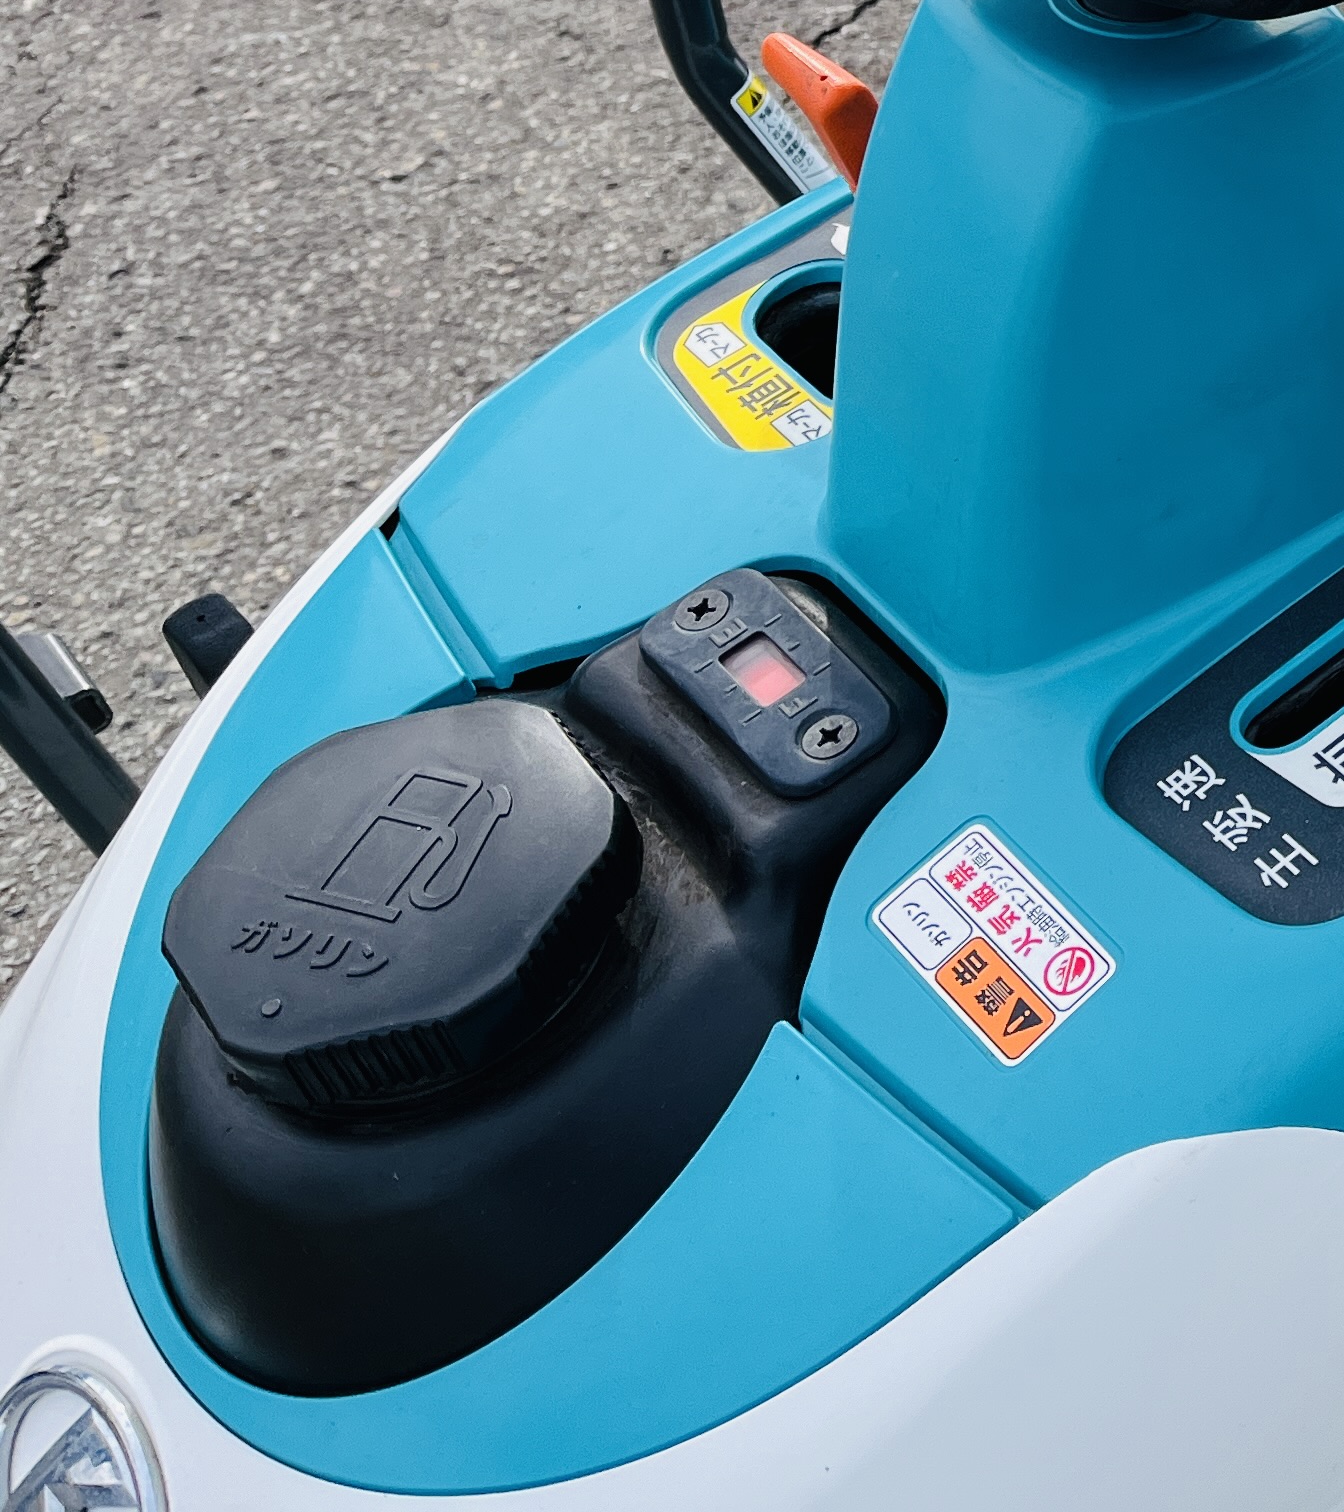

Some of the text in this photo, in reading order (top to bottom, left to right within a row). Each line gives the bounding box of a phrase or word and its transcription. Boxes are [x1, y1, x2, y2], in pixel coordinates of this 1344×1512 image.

[710, 353, 802, 421] 植付
[1156, 754, 1320, 888] 主変速
[902, 902, 954, 948] ガソリン
[944, 859, 1043, 957] 火気厳禁
[962, 838, 1071, 948] 給油時エンジン停止
[230, 920, 389, 978] ガソリン
[951, 949, 1016, 1017] 警告
